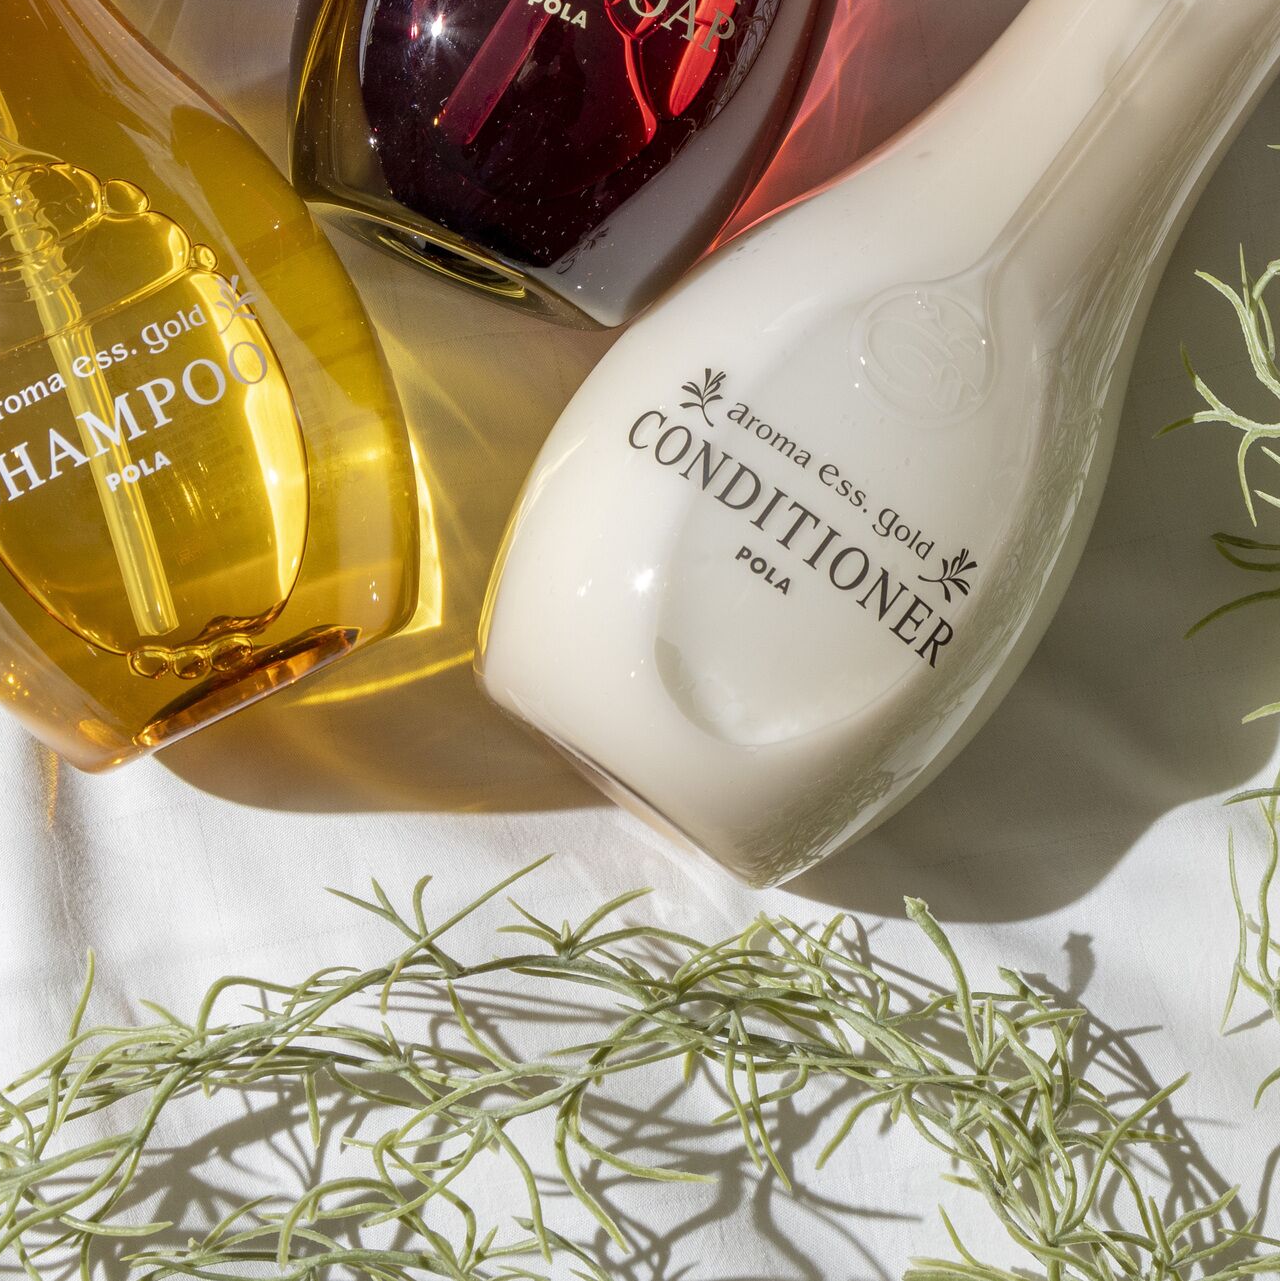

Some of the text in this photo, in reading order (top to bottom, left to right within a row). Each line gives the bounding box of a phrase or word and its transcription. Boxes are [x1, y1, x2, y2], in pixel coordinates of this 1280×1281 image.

[71, 342, 137, 378] ess.
[140, 303, 208, 355] gold
[104, 449, 173, 493] POLA
[726, 401, 936, 562] aroma ess. gold
[627, 409, 955, 670] CONDITIONER
[734, 544, 793, 596] POLA
